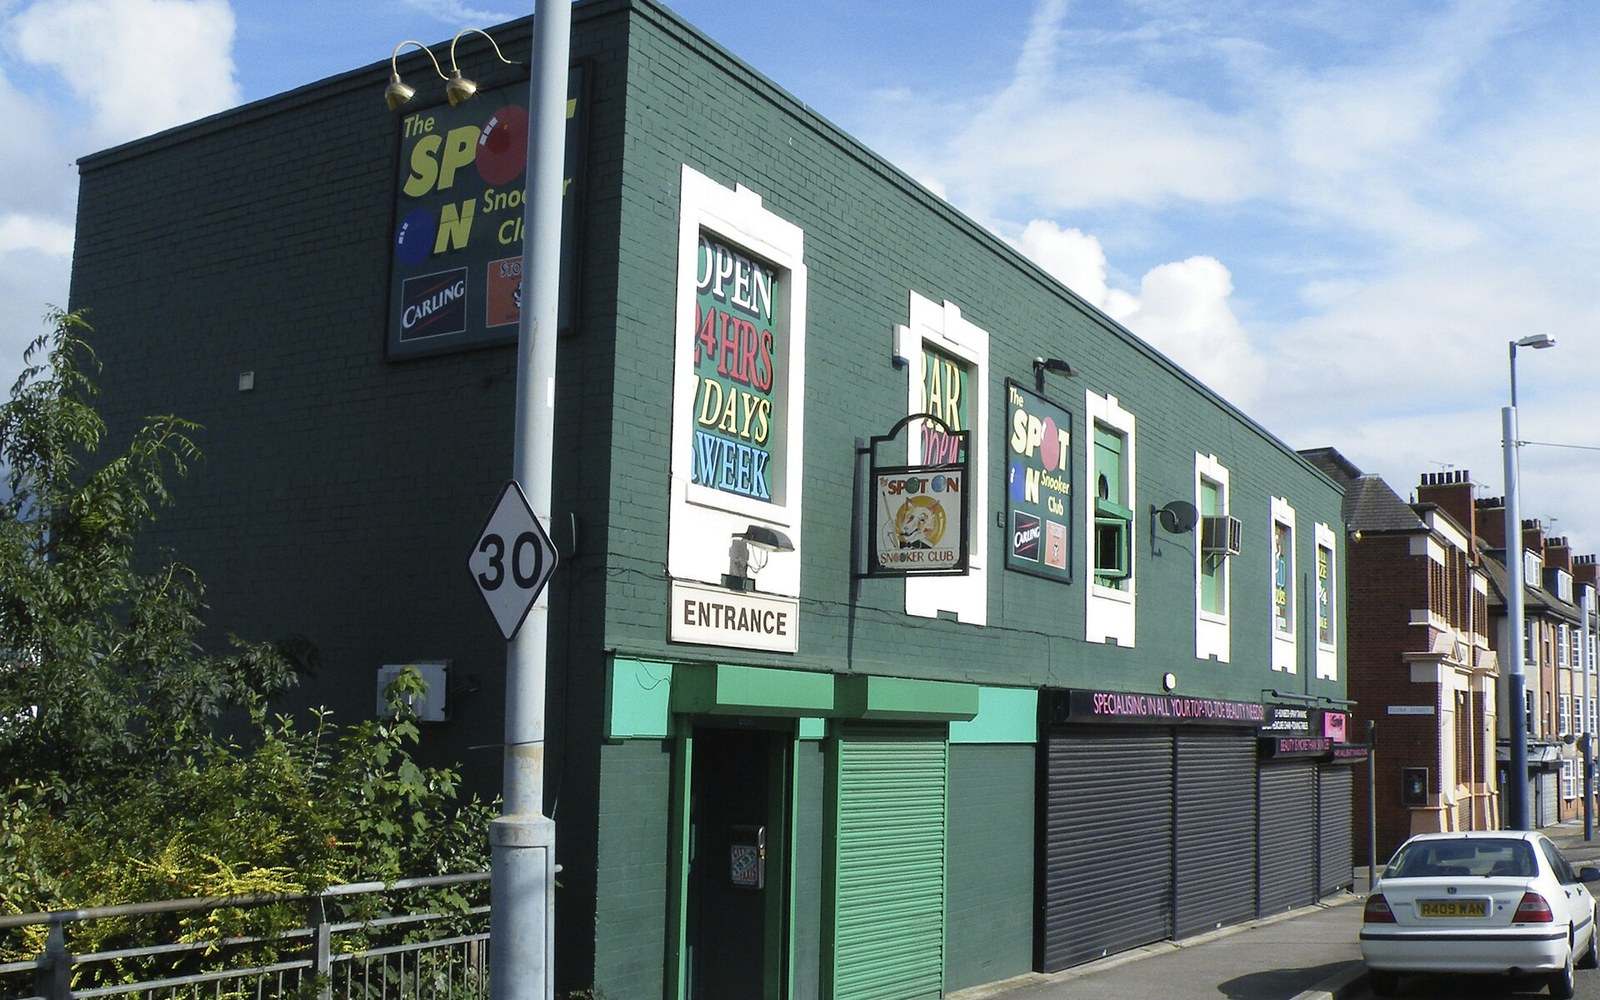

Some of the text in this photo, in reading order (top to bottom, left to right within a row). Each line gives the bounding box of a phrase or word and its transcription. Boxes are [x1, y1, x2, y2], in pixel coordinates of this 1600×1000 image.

[404, 113, 435, 138] The
[697, 235, 773, 321] OPEN
[402, 280, 465, 329] CARLING
[1010, 387, 1024, 407] The
[888, 476, 929, 495] SPOT
[931, 474, 959, 493] ON
[1041, 470, 1071, 495] Snooker
[1048, 496, 1064, 516] Club
[478, 531, 543, 591] 30
[880, 551, 954, 565] SNOOKER CLUB
[683, 600, 787, 636] ENTRANCE
[1093, 692, 1147, 716] SPECIALISING
[1147, 696, 1157, 715] IN
[1157, 697, 1171, 717] ALL
[1170, 698, 1191, 717] YOUR
